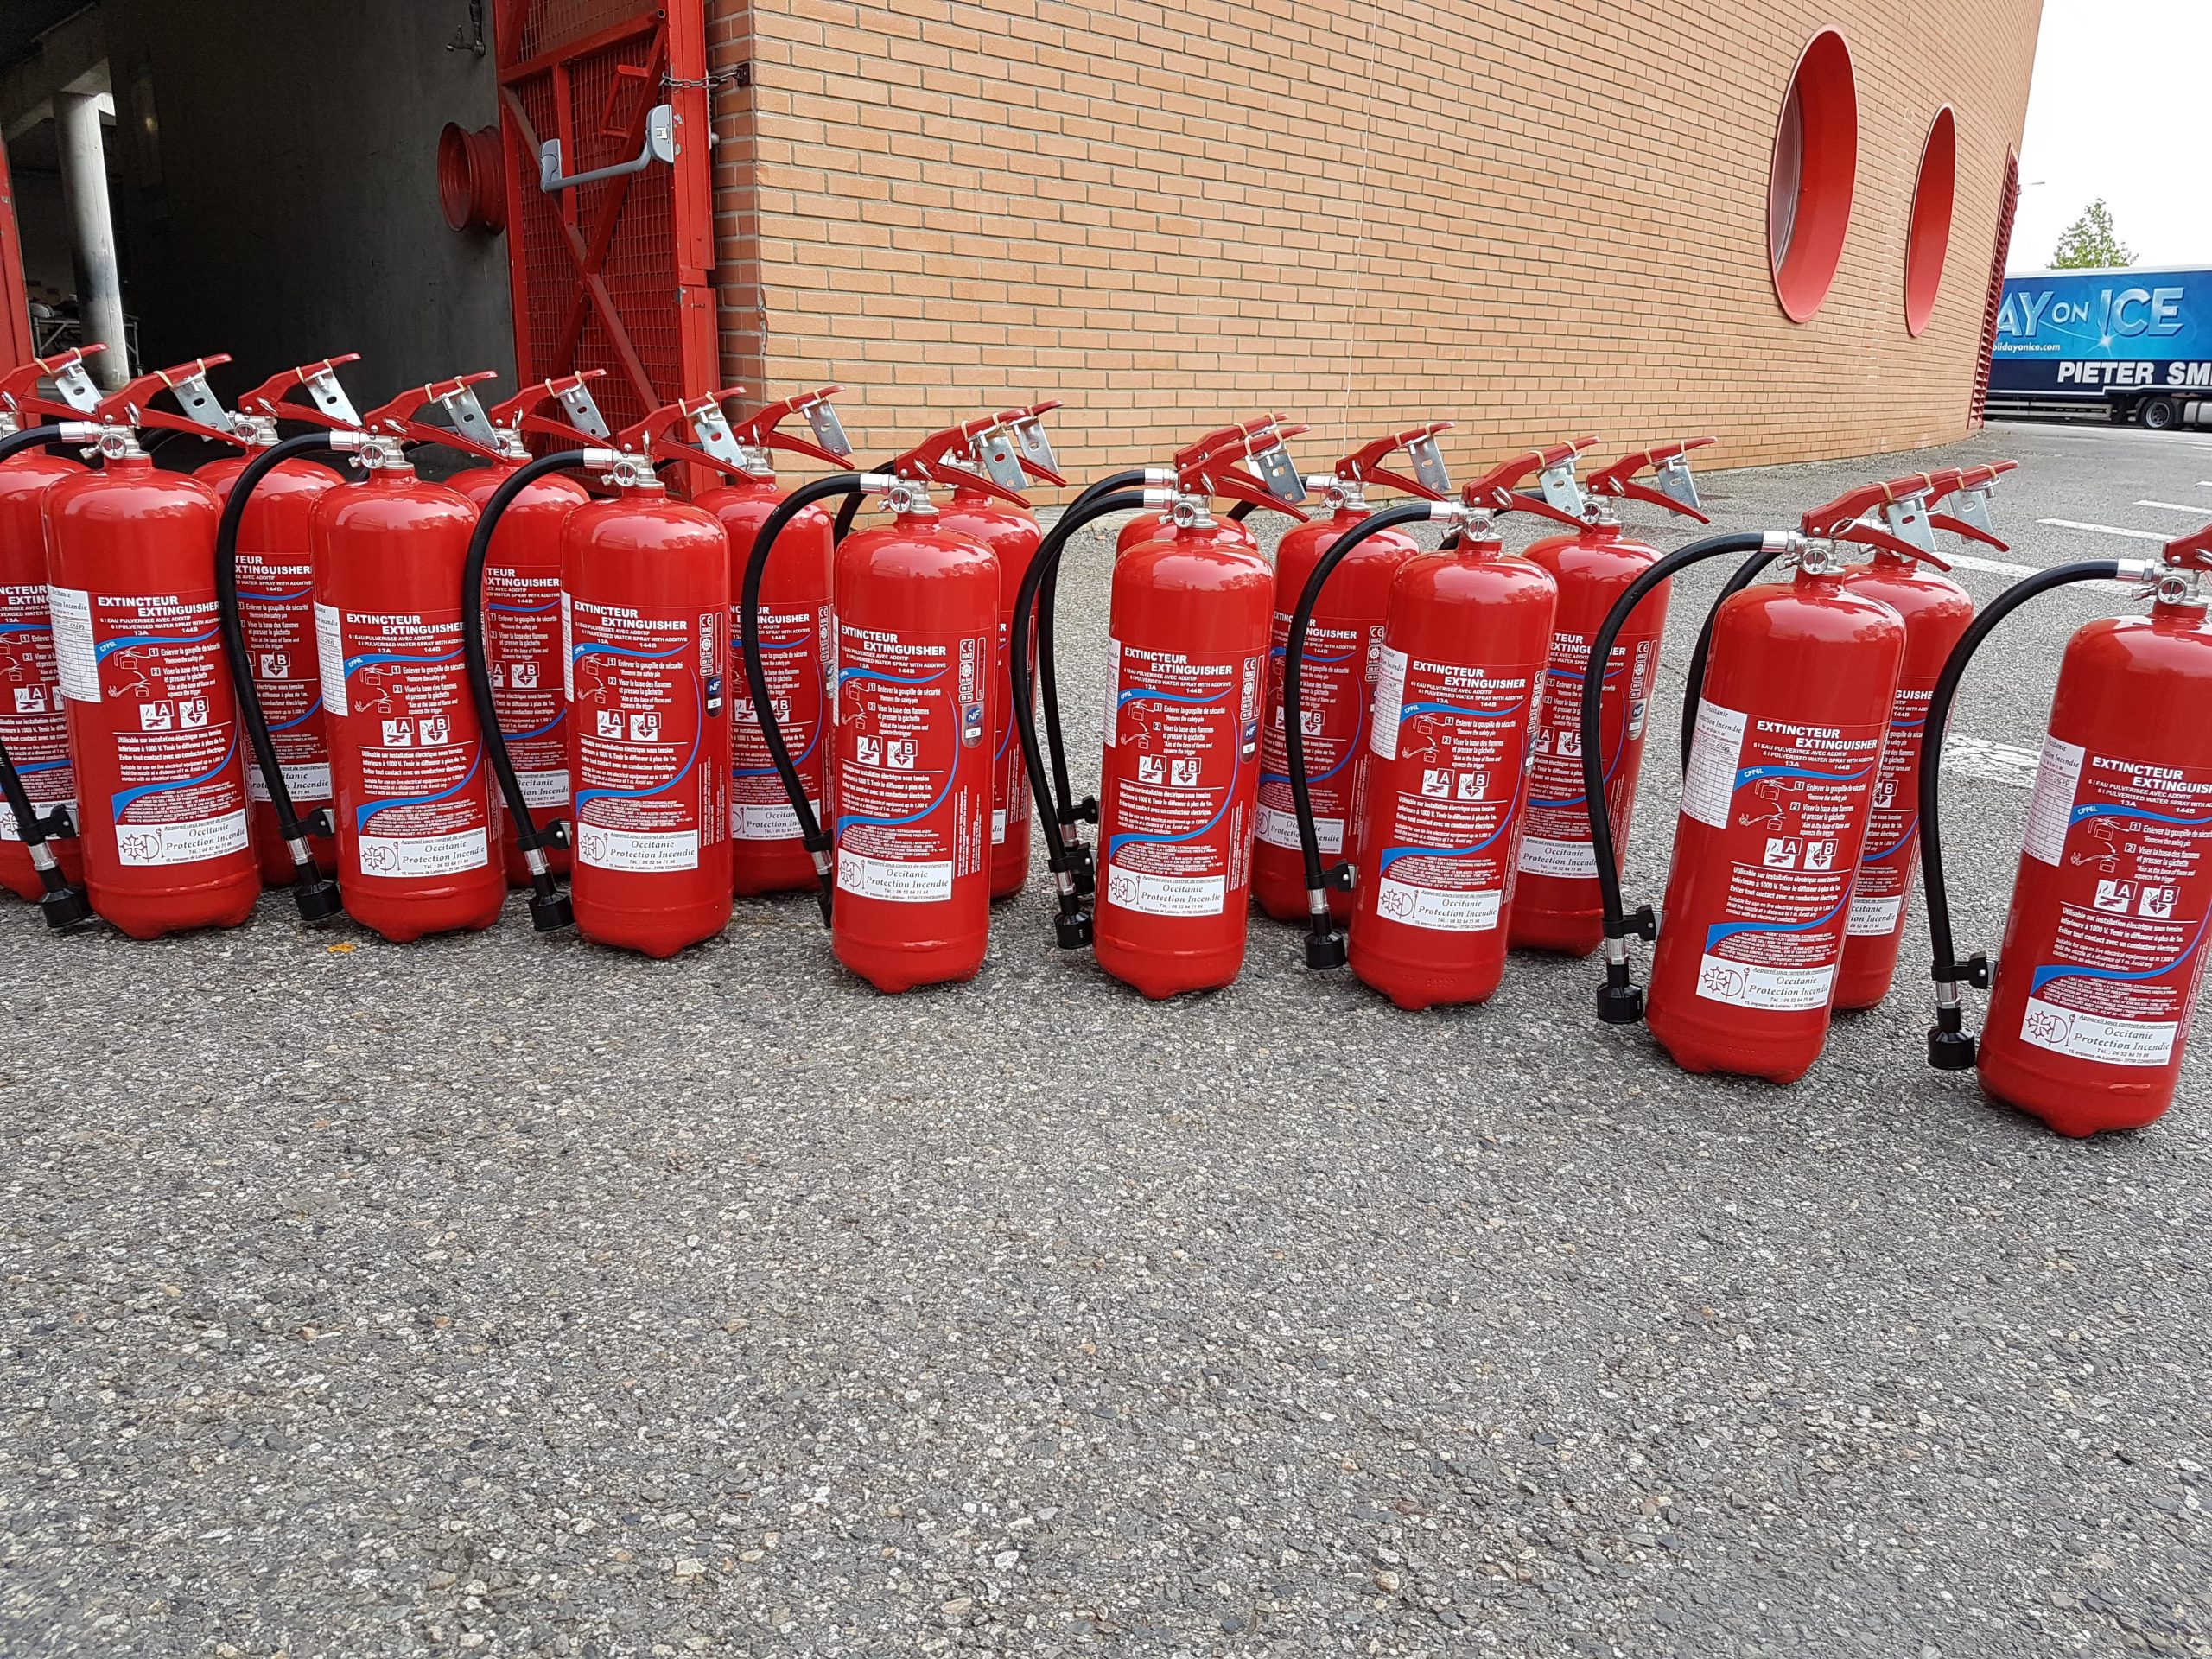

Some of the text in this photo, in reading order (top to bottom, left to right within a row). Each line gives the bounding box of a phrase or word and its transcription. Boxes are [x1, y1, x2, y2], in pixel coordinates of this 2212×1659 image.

[2052, 302, 2089, 323] ON
[2097, 287, 2184, 337] ICE
[2057, 361, 2212, 385] PIETER SM
[235, 566, 312, 575] XTINGUISHER
[488, 578, 560, 587] XTINGUISHER
[98, 596, 178, 607] EXTINCTEUR
[575, 601, 638, 618] EXTINCTEUR
[346, 613, 421, 625] EXTINCTEUR
[601, 617, 687, 629] EXTINGUISHER
[842, 626, 898, 643] EXTINCTEUR
[864, 642, 946, 655] EXTINGUISHER
[277, 655, 286, 664] B
[1125, 647, 1187, 664] EXTINCTEUR
[494, 664, 502, 674] A
[527, 665, 536, 674] B
[1151, 663, 1232, 675] EXTINGUISHER
[1413, 661, 1484, 677] EXTINCTEUR
[710, 680, 721, 691] NF
[1445, 677, 1525, 689] EXTINGUISHER
[33, 687, 42, 698] A
[159, 704, 169, 715] A
[196, 700, 206, 712] B
[780, 701, 788, 709] B
[612, 714, 621, 724] A
[968, 709, 981, 721] NF
[1313, 714, 1321, 723] B
[399, 721, 410, 732] A
[437, 719, 446, 729] B
[647, 716, 657, 727] B
[1245, 727, 1255, 736] NF
[1541, 730, 1549, 740] A
[1757, 721, 1840, 739] EXTINCTEUR
[870, 740, 880, 751] A
[905, 742, 913, 754] B
[1796, 738, 1877, 751] EXTINGUISHER
[1770, 753, 1807, 761] PULVERISED
[1154, 759, 1162, 769] A
[1188, 761, 1197, 772] B
[2092, 757, 2183, 779] EXTINCTEUR
[1440, 772, 1449, 783] A
[1744, 768, 1764, 778] CPP6L
[1476, 774, 1484, 785] B
[540, 786, 568, 795] Incendi
[1885, 784, 1892, 794] B
[189, 824, 229, 837] Occitanie
[1271, 826, 1300, 837] Protectio
[166, 829, 245, 850] Protection Incendie
[425, 841, 467, 853] Occitanie
[1545, 847, 1584, 857] Occitanie
[1785, 841, 1796, 853] A
[1823, 843, 1833, 854] B
[403, 846, 485, 864] Protection Incendie
[610, 848, 695, 858] Protection Incendie
[1523, 853, 1566, 865] Protection
[887, 868, 928, 878] Occitanie
[866, 876, 948, 888] Protection Incendie
[2118, 884, 2130, 897] A
[2163, 889, 2172, 902] B
[1141, 891, 1221, 903] Protection Incendie
[1419, 906, 1497, 918] Protection Incendie
[1776, 976, 1817, 985] Occitanie
[1749, 984, 1828, 996] Protection Incendie
[2104, 1027, 2153, 1039] Occitanie
[2074, 1033, 2170, 1051] Protection Incendie
